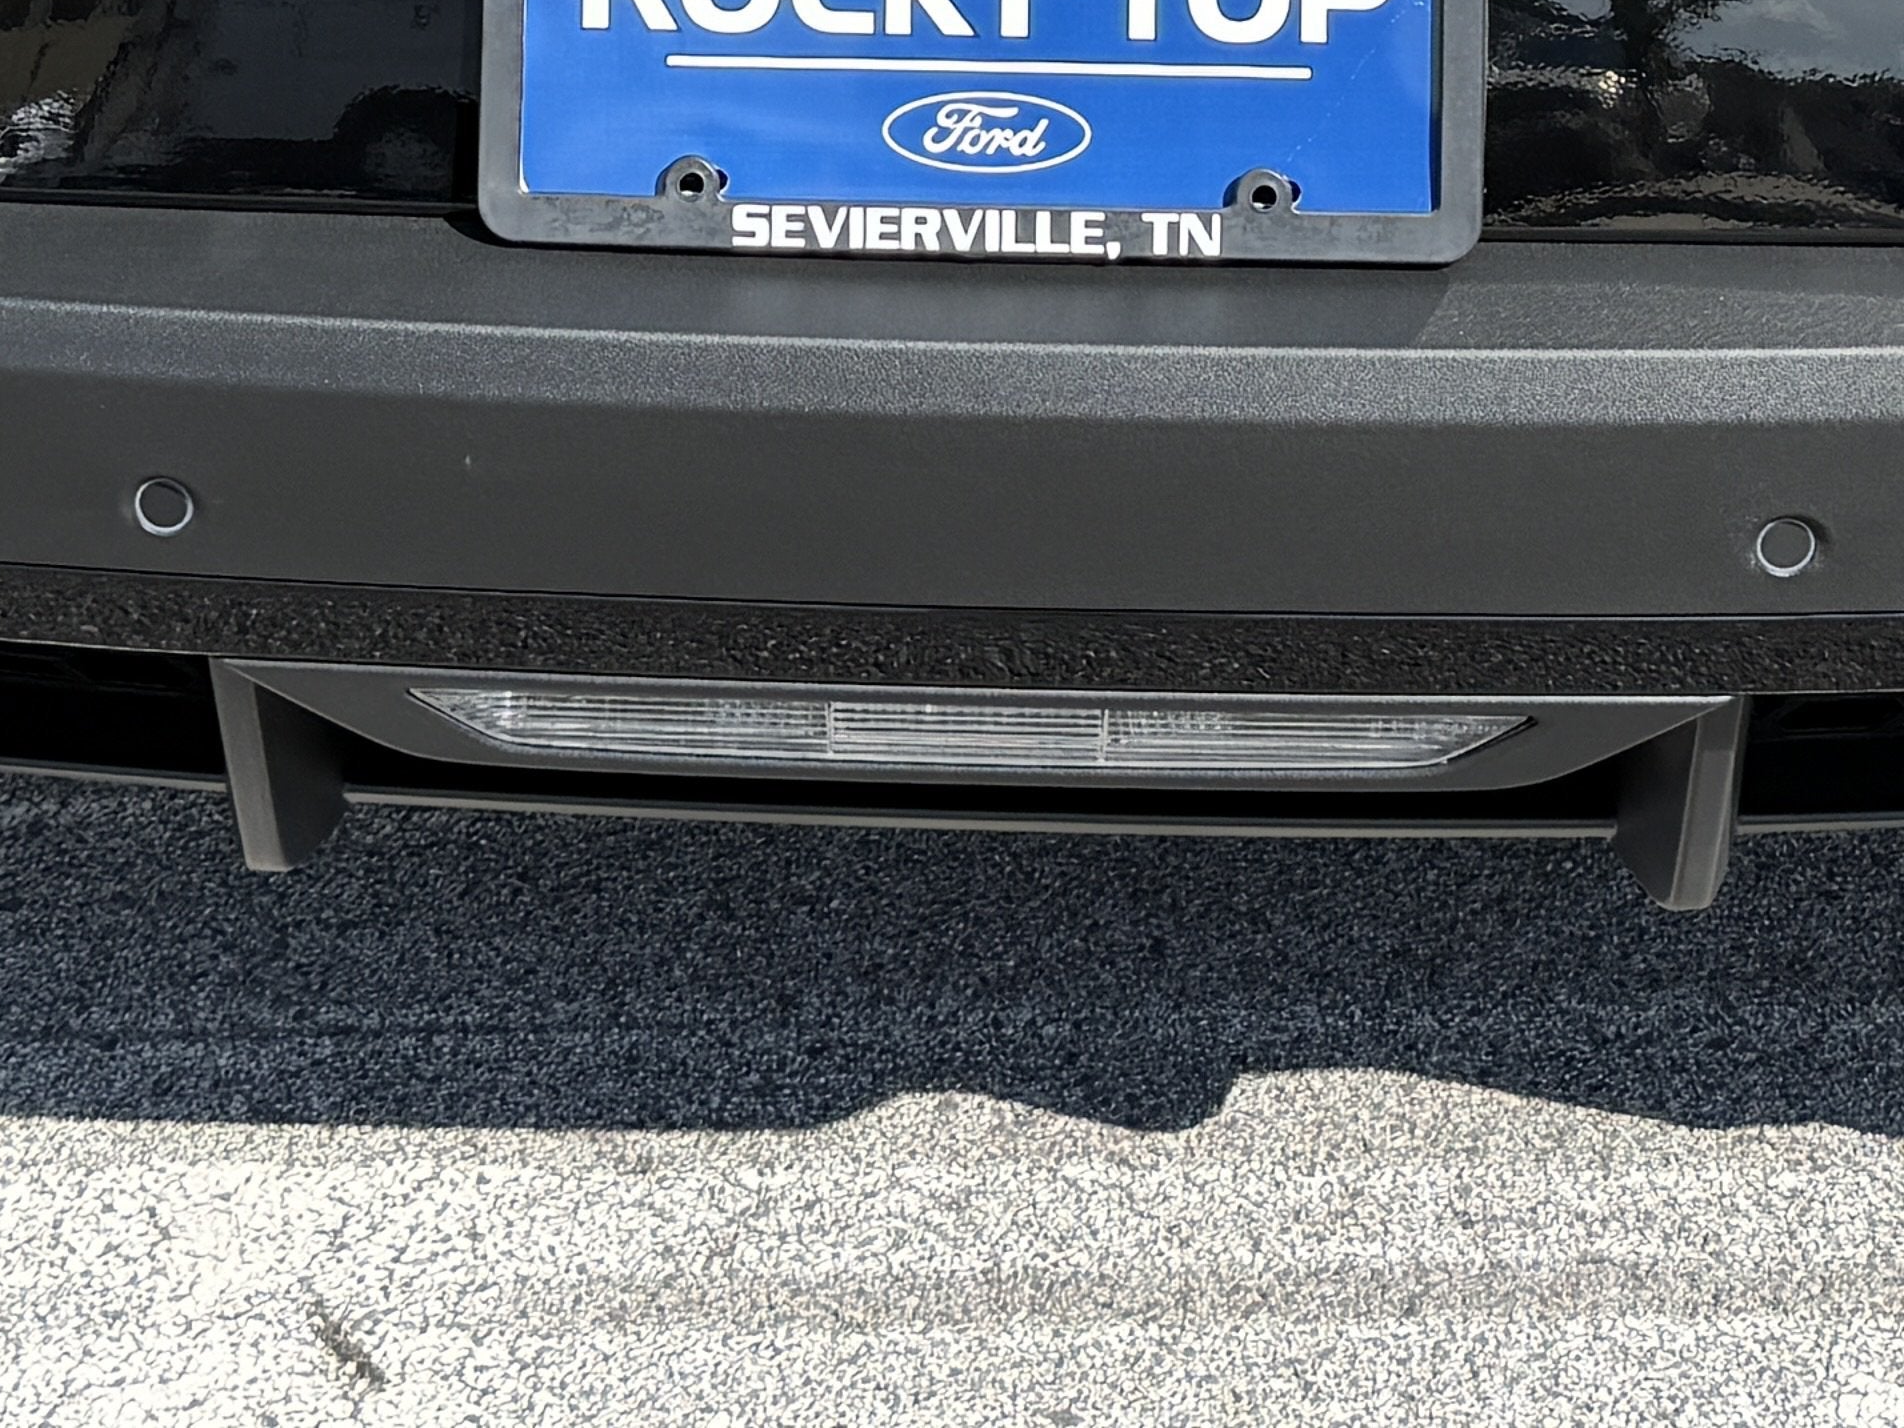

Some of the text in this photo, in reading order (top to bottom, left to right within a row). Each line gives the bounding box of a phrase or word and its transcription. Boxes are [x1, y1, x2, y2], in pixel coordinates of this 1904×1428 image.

[922, 102, 1050, 157] Ford
[730, 203, 1222, 261] SEVIERVILLE, TN
